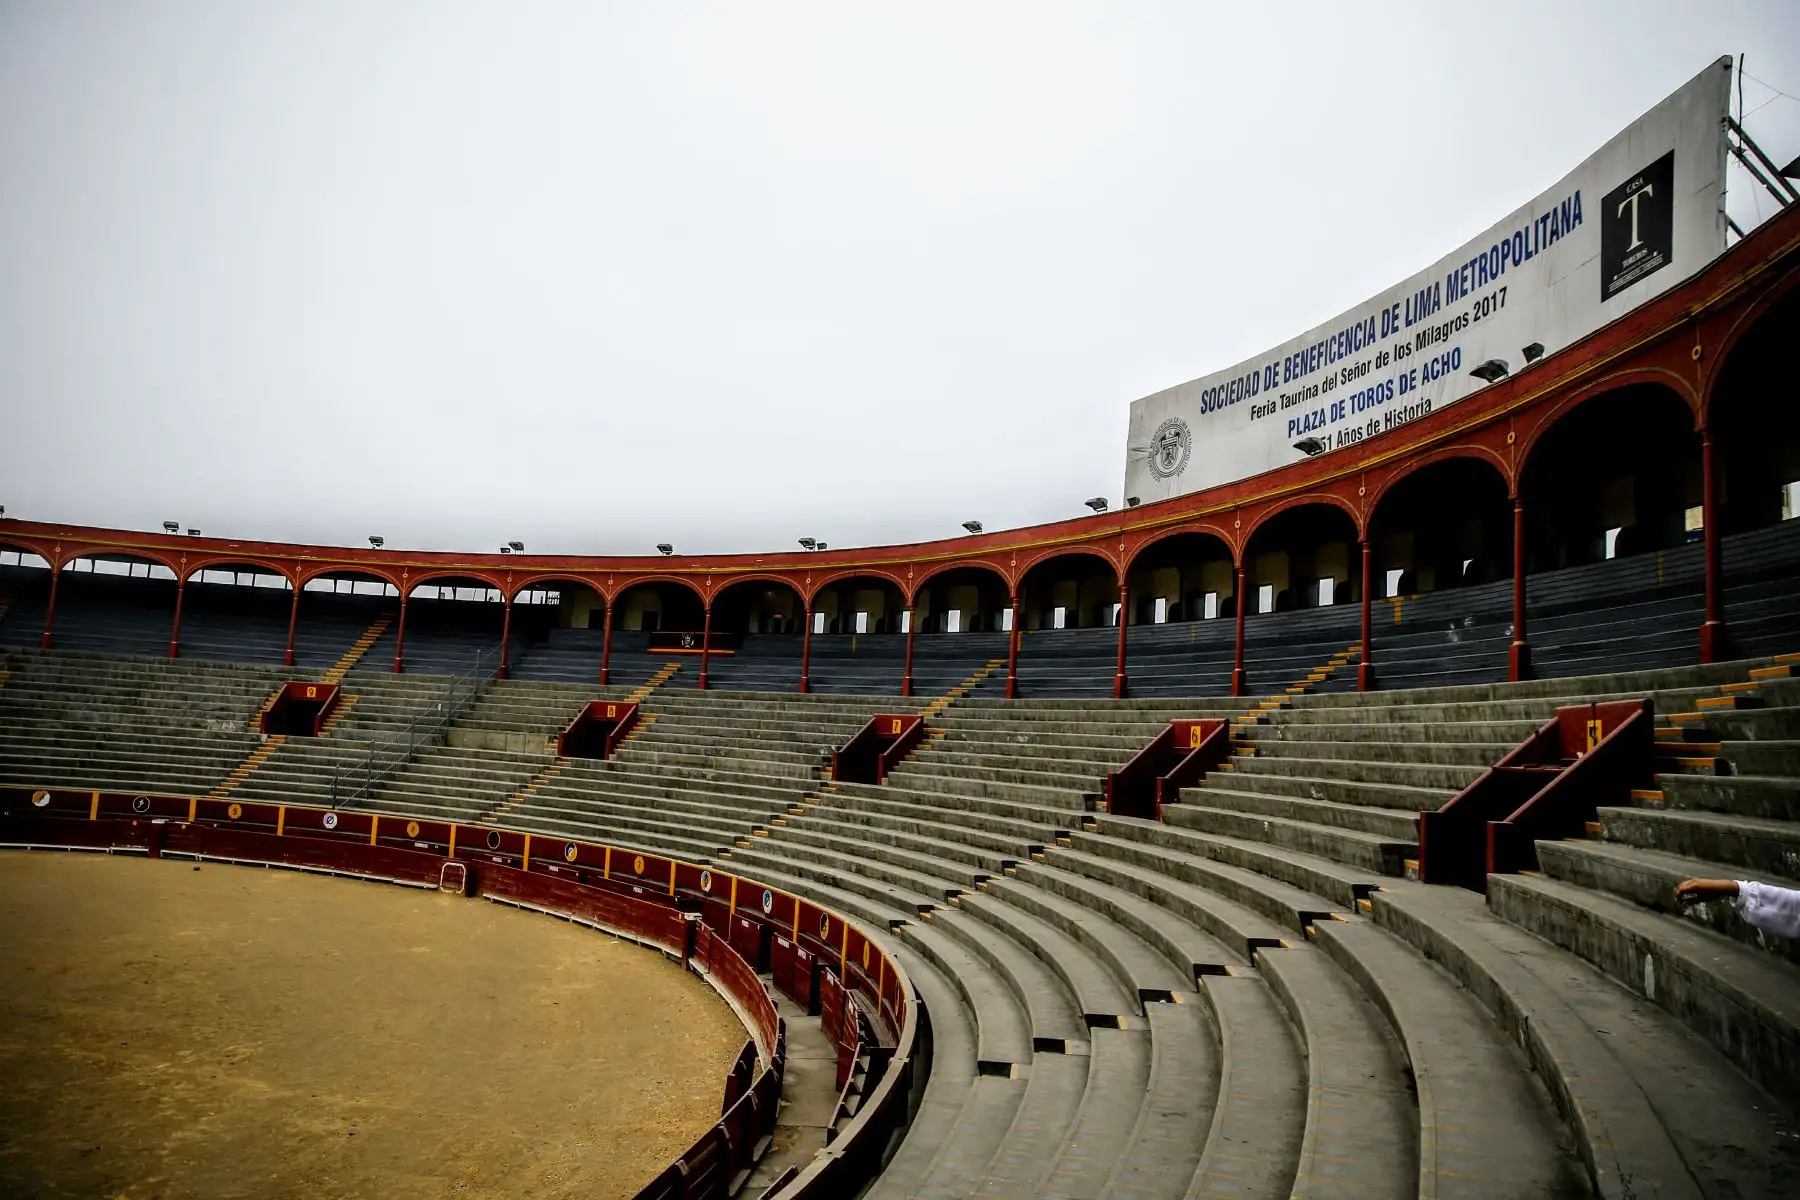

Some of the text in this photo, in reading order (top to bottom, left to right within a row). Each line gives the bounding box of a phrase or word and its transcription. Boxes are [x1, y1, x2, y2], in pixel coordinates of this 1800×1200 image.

[1617, 183, 1653, 252] T
[1200, 370, 1260, 415] SOCIEDAD
[1263, 361, 1280, 392] DE
[1283, 315, 1376, 384] BENEFICENCIA
[1381, 302, 1400, 339] DE
[1405, 281, 1441, 328] LIMA
[1446, 189, 1583, 306] METROPOLITANA
[1250, 285, 1508, 421] Feria Taurina del Señor de los Milagros 2017
[1287, 346, 1461, 439] PLAZA DE TOROS DE ACHO
[1336, 426, 1363, 448] Años
[1366, 418, 1381, 437] de
[1384, 397, 1432, 430] Historia
